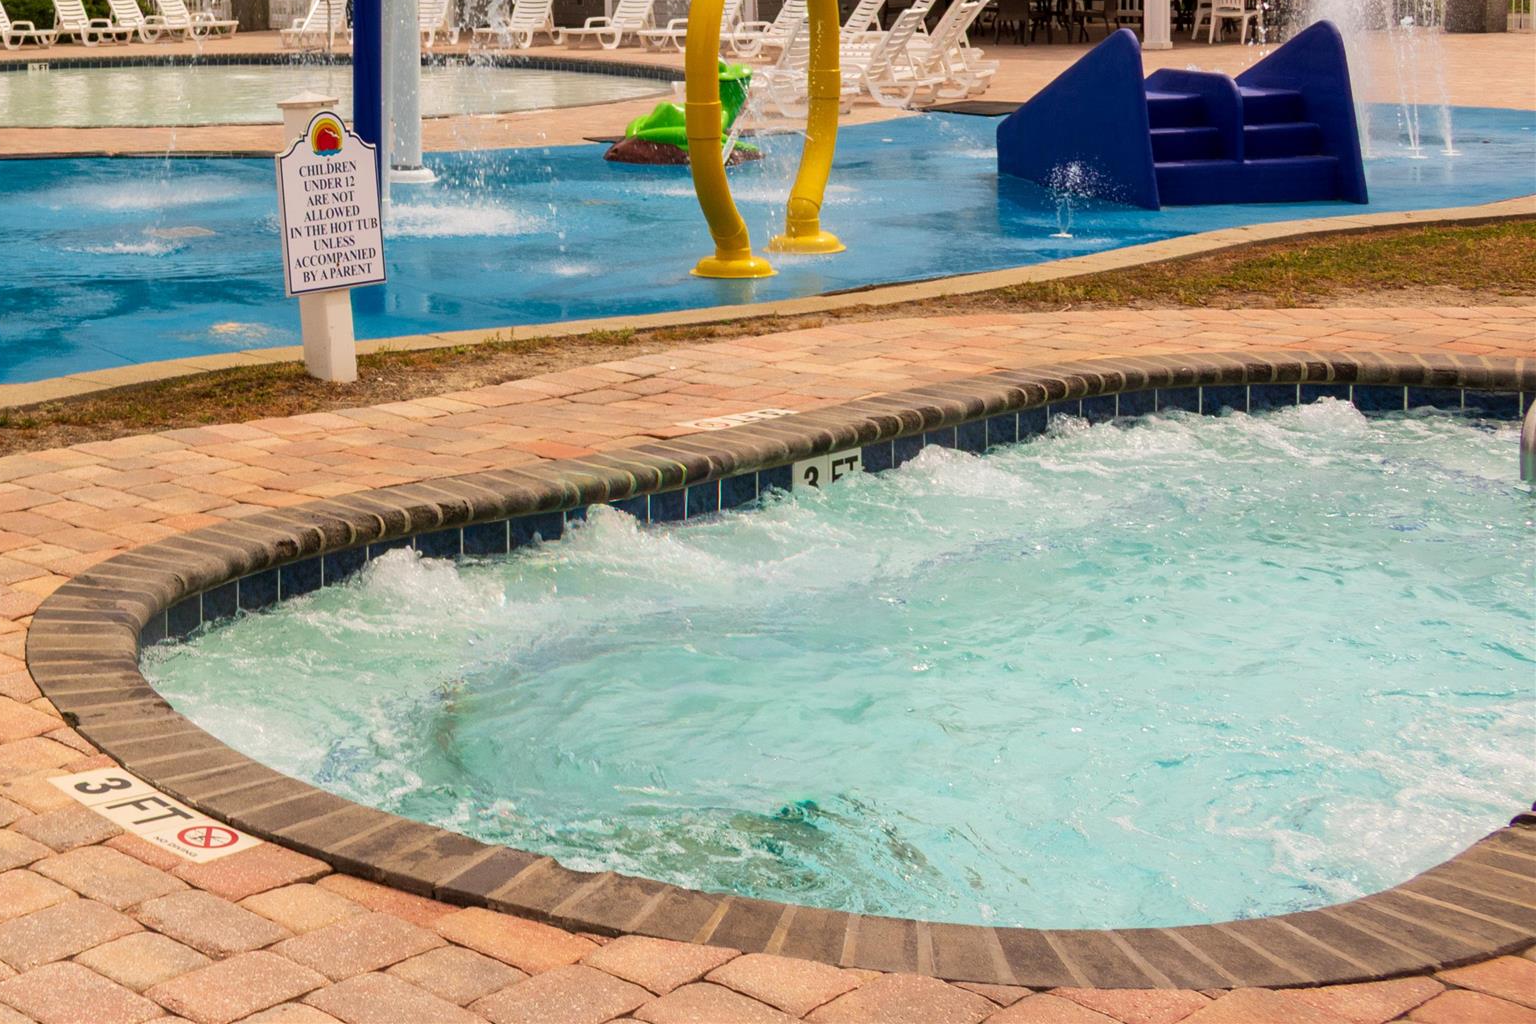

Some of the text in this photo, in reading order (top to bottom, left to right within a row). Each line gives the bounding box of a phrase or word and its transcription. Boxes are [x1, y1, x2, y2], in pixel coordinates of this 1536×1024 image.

[299, 161, 357, 177] CHILDREN
[304, 175, 355, 192] UNDER 12
[307, 190, 356, 207] ARE NOT
[304, 204, 360, 222] ALLOWED
[290, 217, 378, 239] IN THE HOT TUB
[314, 236, 355, 251] UNLESS
[294, 247, 376, 269] ACCOMPANIED
[303, 262, 372, 283] BY A PARENT
[803, 455, 858, 488] 3 FT
[73, 777, 194, 825] 3 FT
